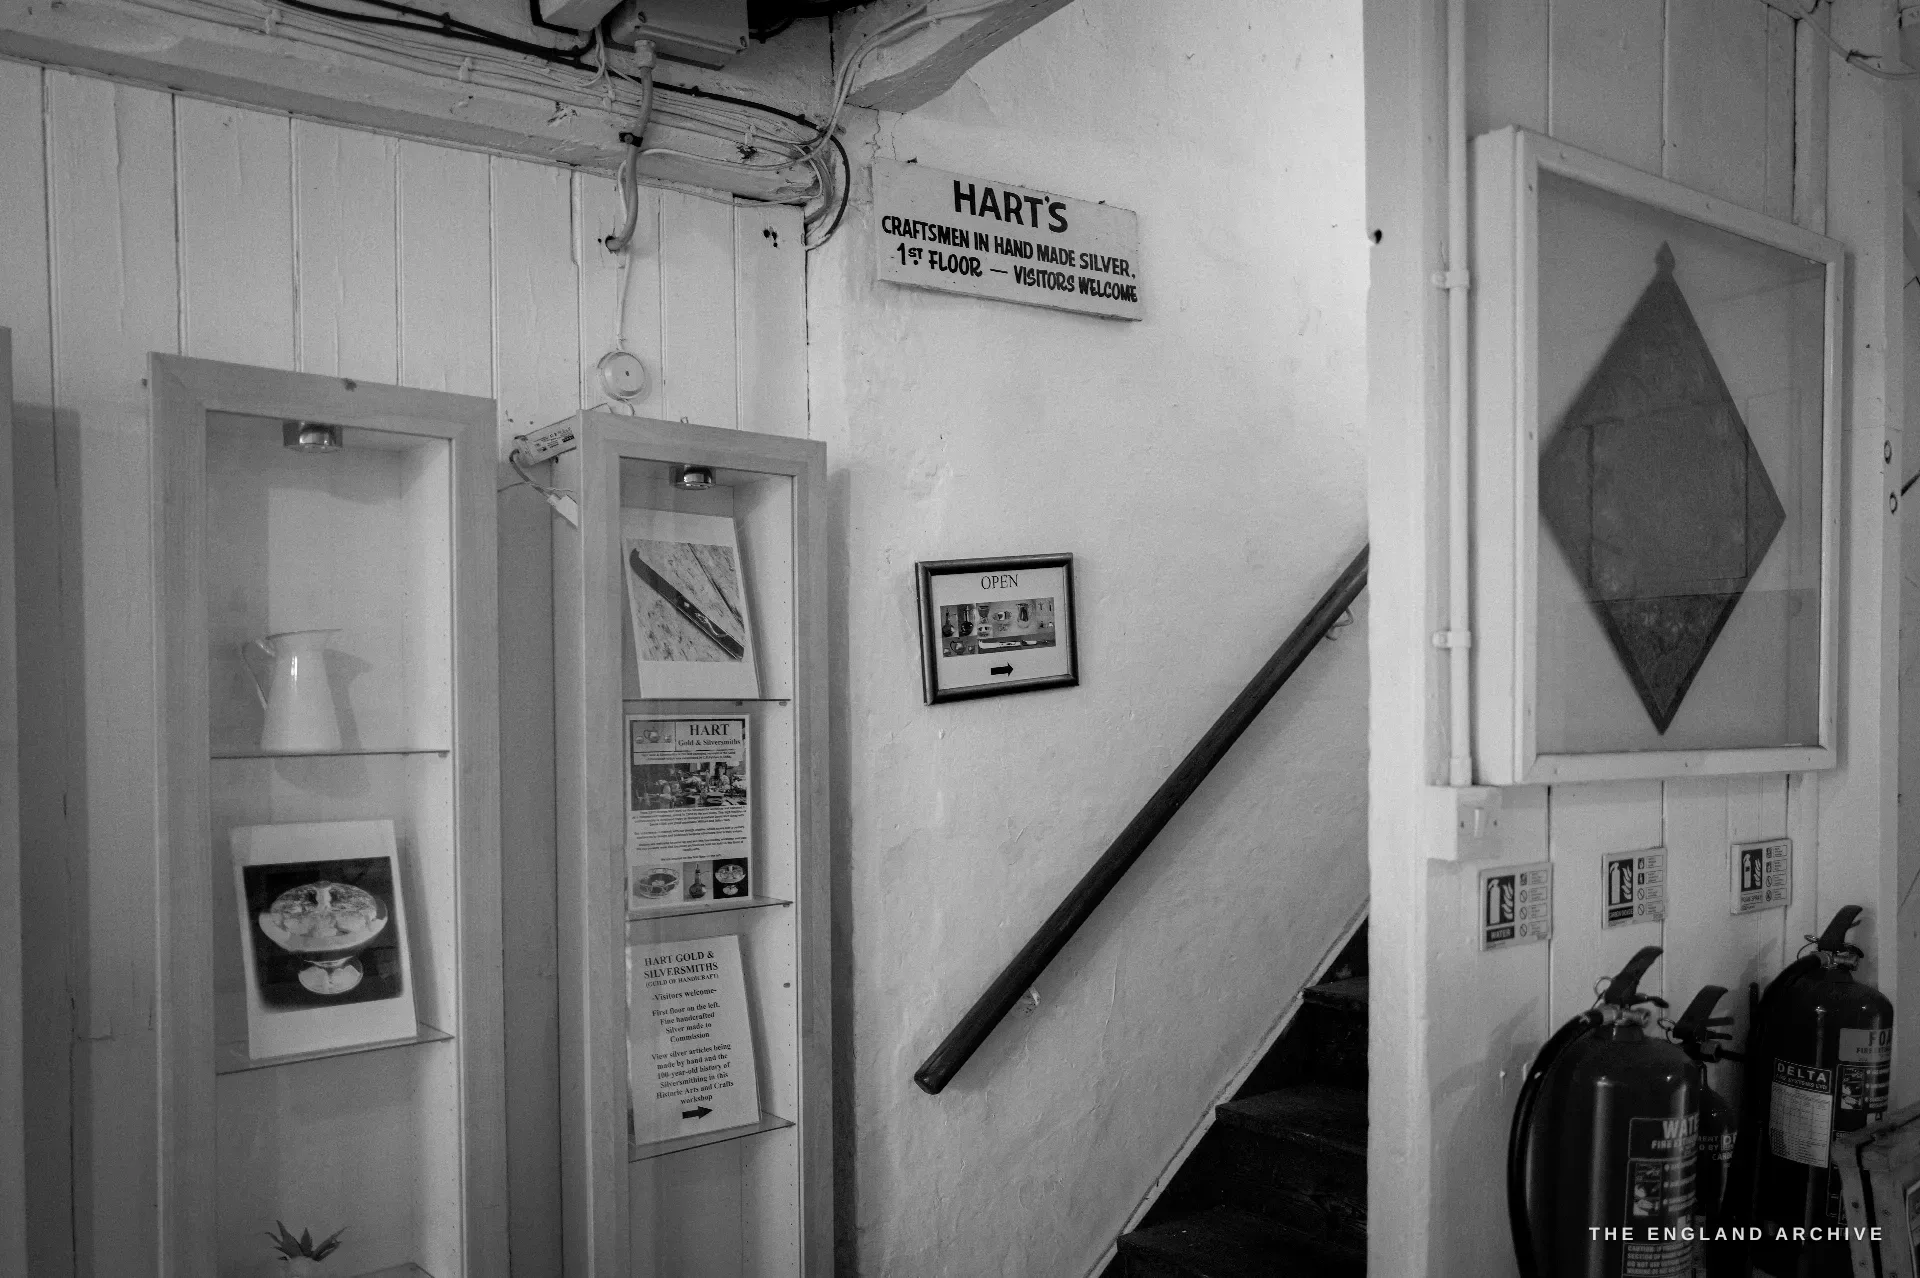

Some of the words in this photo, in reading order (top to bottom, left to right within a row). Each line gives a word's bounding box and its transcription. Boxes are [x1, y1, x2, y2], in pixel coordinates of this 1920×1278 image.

[954, 180, 1068, 233] HART'S
[882, 215, 970, 249] CRAFTSMEN
[974, 231, 989, 252] IN
[994, 236, 1034, 260] HAND
[1036, 244, 1075, 268] MADE
[1080, 252, 1136, 279] SILVER,
[929, 250, 982, 277] FLOOR
[1014, 265, 1075, 293] VISITORS
[1078, 276, 1138, 303] WELCOME
[981, 574, 1018, 590] OPEN
[690, 724, 729, 736] HART
[703, 738, 740, 746] Silversmiths
[644, 955, 672, 966] HART
[676, 952, 704, 962] GOLD
[707, 950, 714, 958] &
[644, 962, 718, 979] SILVERSMITHS
[652, 1009, 668, 1017] First
[670, 1006, 685, 1014] floor
[676, 1011, 715, 1023] handcrafted
[666, 1026, 684, 1034] Silver
[686, 1023, 704, 1031] made
[670, 1032, 710, 1042] Commission
[652, 1052, 668, 1060] View
[670, 1050, 687, 1058] silver
[689, 1046, 712, 1055] articles
[713, 1043, 731, 1051] being
[657, 1062, 675, 1070] made
[676, 1060, 684, 1068] by
[686, 1057, 703, 1065] hand
[700, 1064, 721, 1074] history
[660, 1075, 708, 1088] Silversmithing
[717, 1071, 728, 1079] this
[1777, 1063, 1826, 1083] DELTA
[656, 1089, 683, 1099] Historic
[684, 1087, 698, 1095] Arts
[714, 1080, 734, 1089] Crafts
[680, 1094, 712, 1105] workshop
[1651, 1140, 1672, 1149] FIRE
